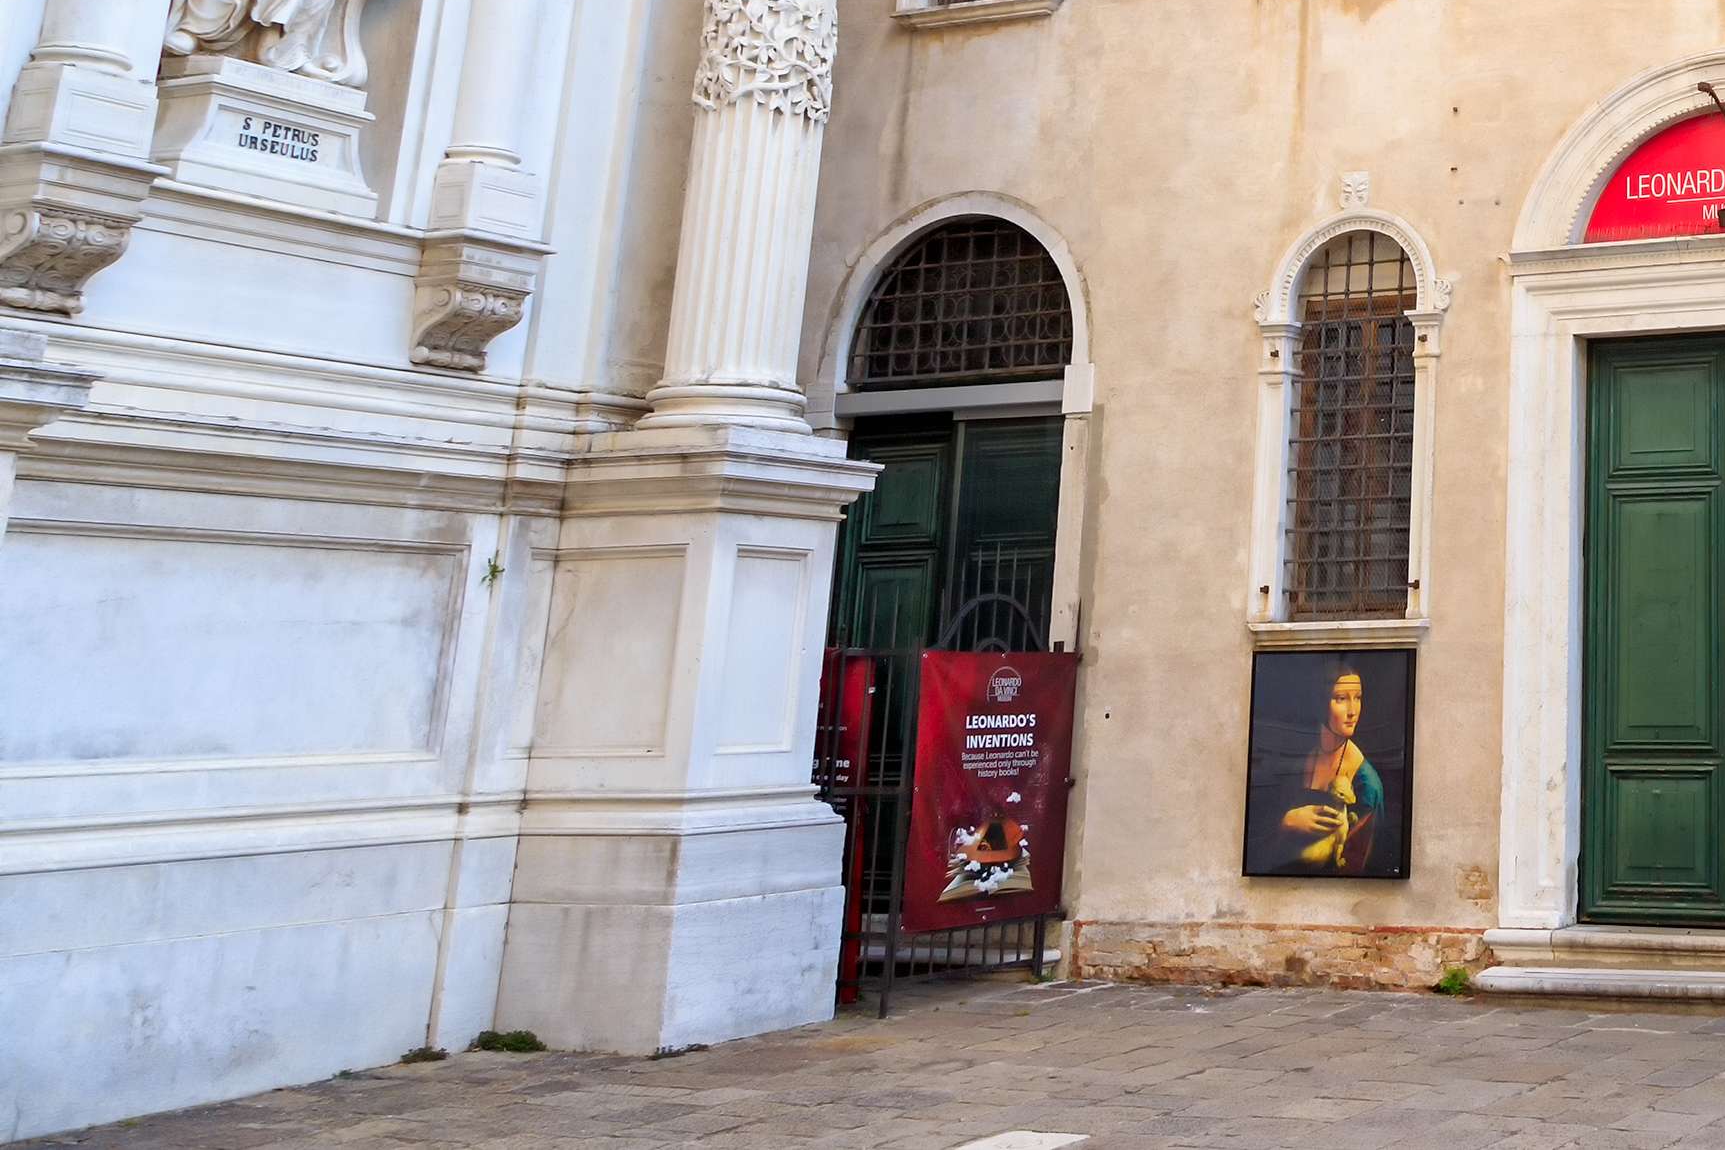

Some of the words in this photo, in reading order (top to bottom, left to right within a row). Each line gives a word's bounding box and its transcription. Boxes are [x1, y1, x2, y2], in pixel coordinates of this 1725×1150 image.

[242, 116, 253, 131] S
[262, 121, 320, 147] PETRUS
[239, 133, 318, 162] URSEULUS
[966, 714, 1036, 729] LEONARDO'S
[966, 733, 1034, 749] INVENTIONS
[962, 752, 984, 761] Because
[985, 750, 1014, 759] Leonardo
[1015, 750, 1029, 758] can't
[963, 761, 997, 770] experienced
[998, 760, 1011, 769] only
[1012, 758, 1037, 768] through
[977, 769, 998, 779] history
[999, 768, 1020, 777] books!
